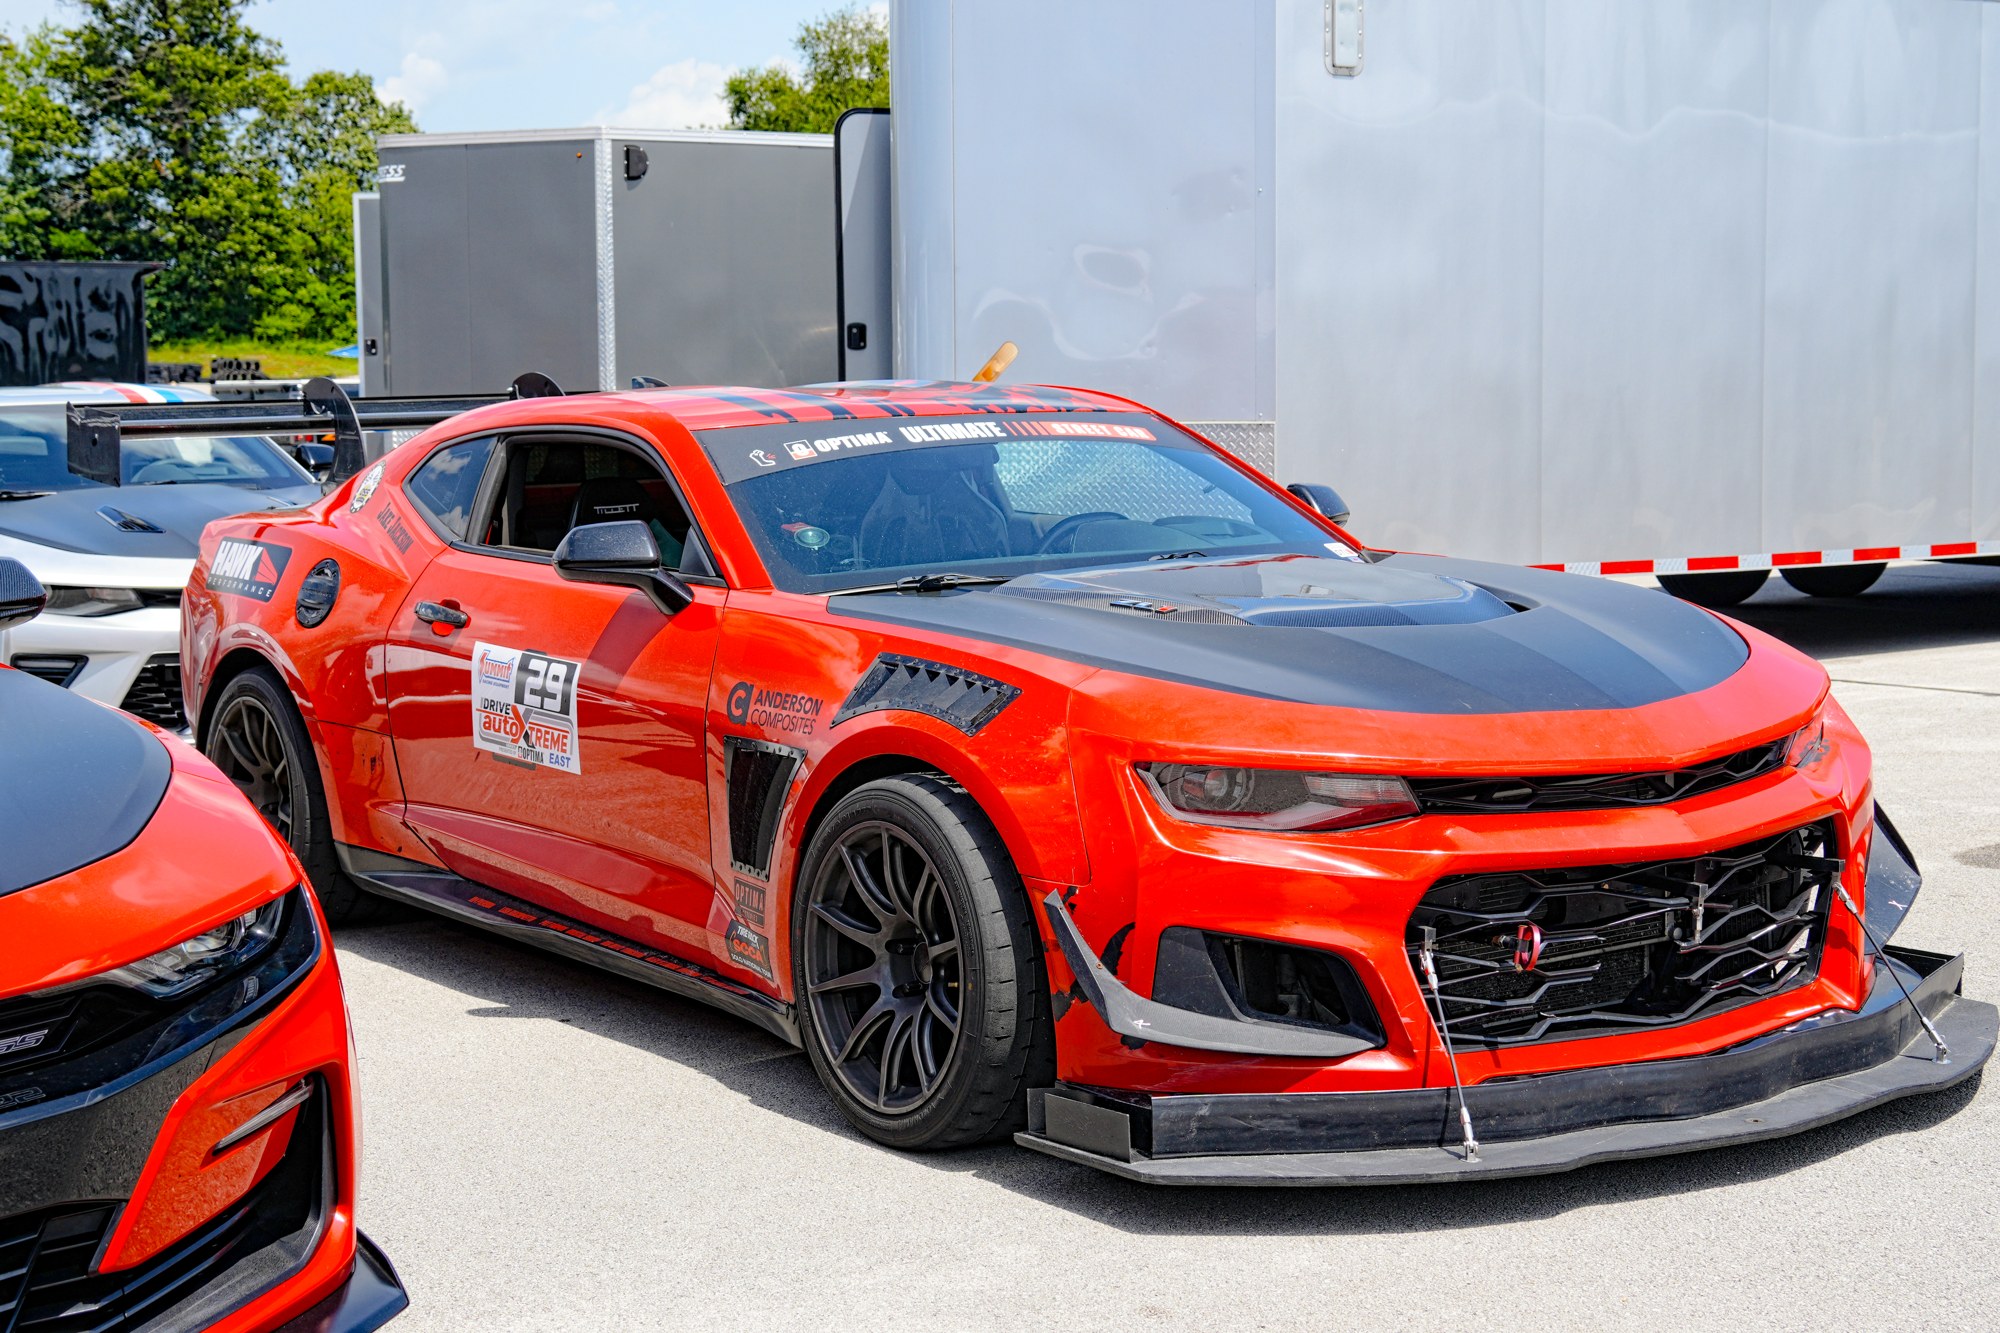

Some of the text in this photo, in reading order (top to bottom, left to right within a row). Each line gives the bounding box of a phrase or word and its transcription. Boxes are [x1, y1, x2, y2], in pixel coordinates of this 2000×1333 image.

[814, 420, 1149, 453] OPTIMA ULTIMATE STREET CAR
[386, 516, 414, 555] JACKSON
[211, 540, 264, 581] HAWK
[207, 576, 273, 598] PERFORMANCE
[523, 658, 567, 712] 29
[483, 698, 511, 715] DRIVE
[754, 689, 823, 716] ANDERSON
[751, 708, 816, 735] COMPOSITES
[522, 748, 544, 764] OPTIMA
[549, 753, 571, 768] EAST
[735, 883, 764, 911] OPTIMA
[733, 939, 763, 961] SCCA
